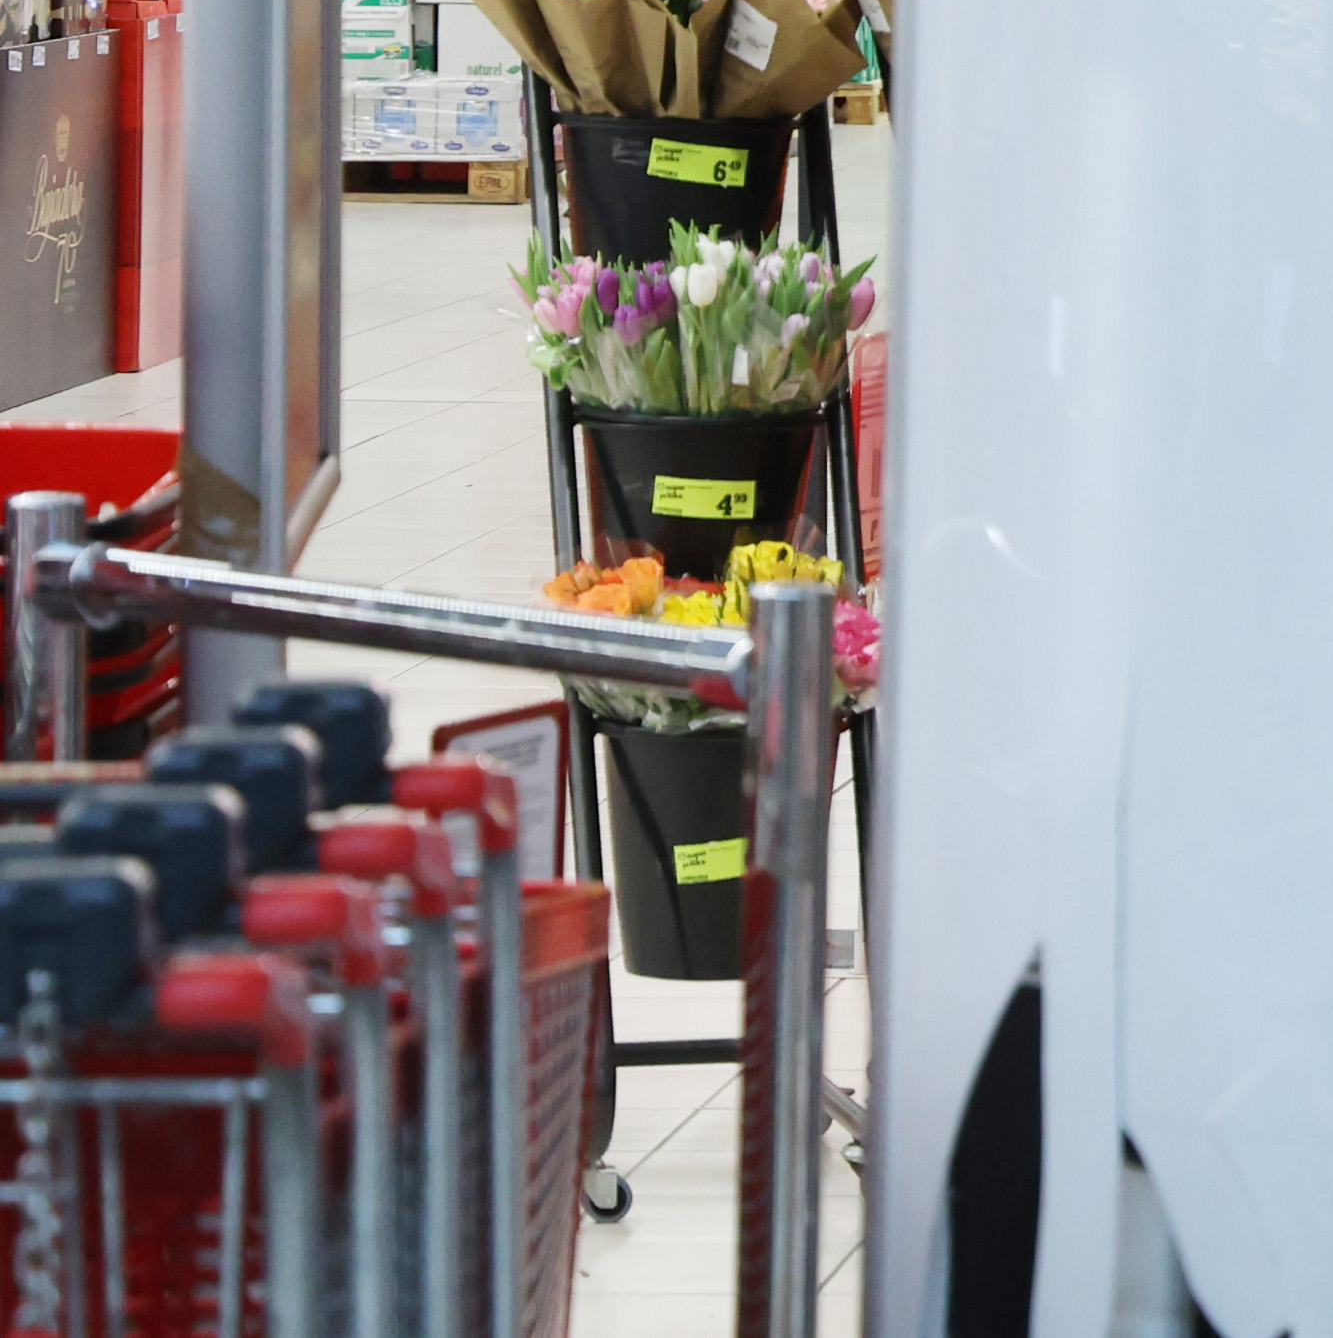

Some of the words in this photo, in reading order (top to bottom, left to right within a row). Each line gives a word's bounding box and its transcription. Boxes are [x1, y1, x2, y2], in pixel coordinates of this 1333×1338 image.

[467, 63, 502, 75] naturel
[713, 160, 727, 182] 6
[715, 493, 732, 516] 4
